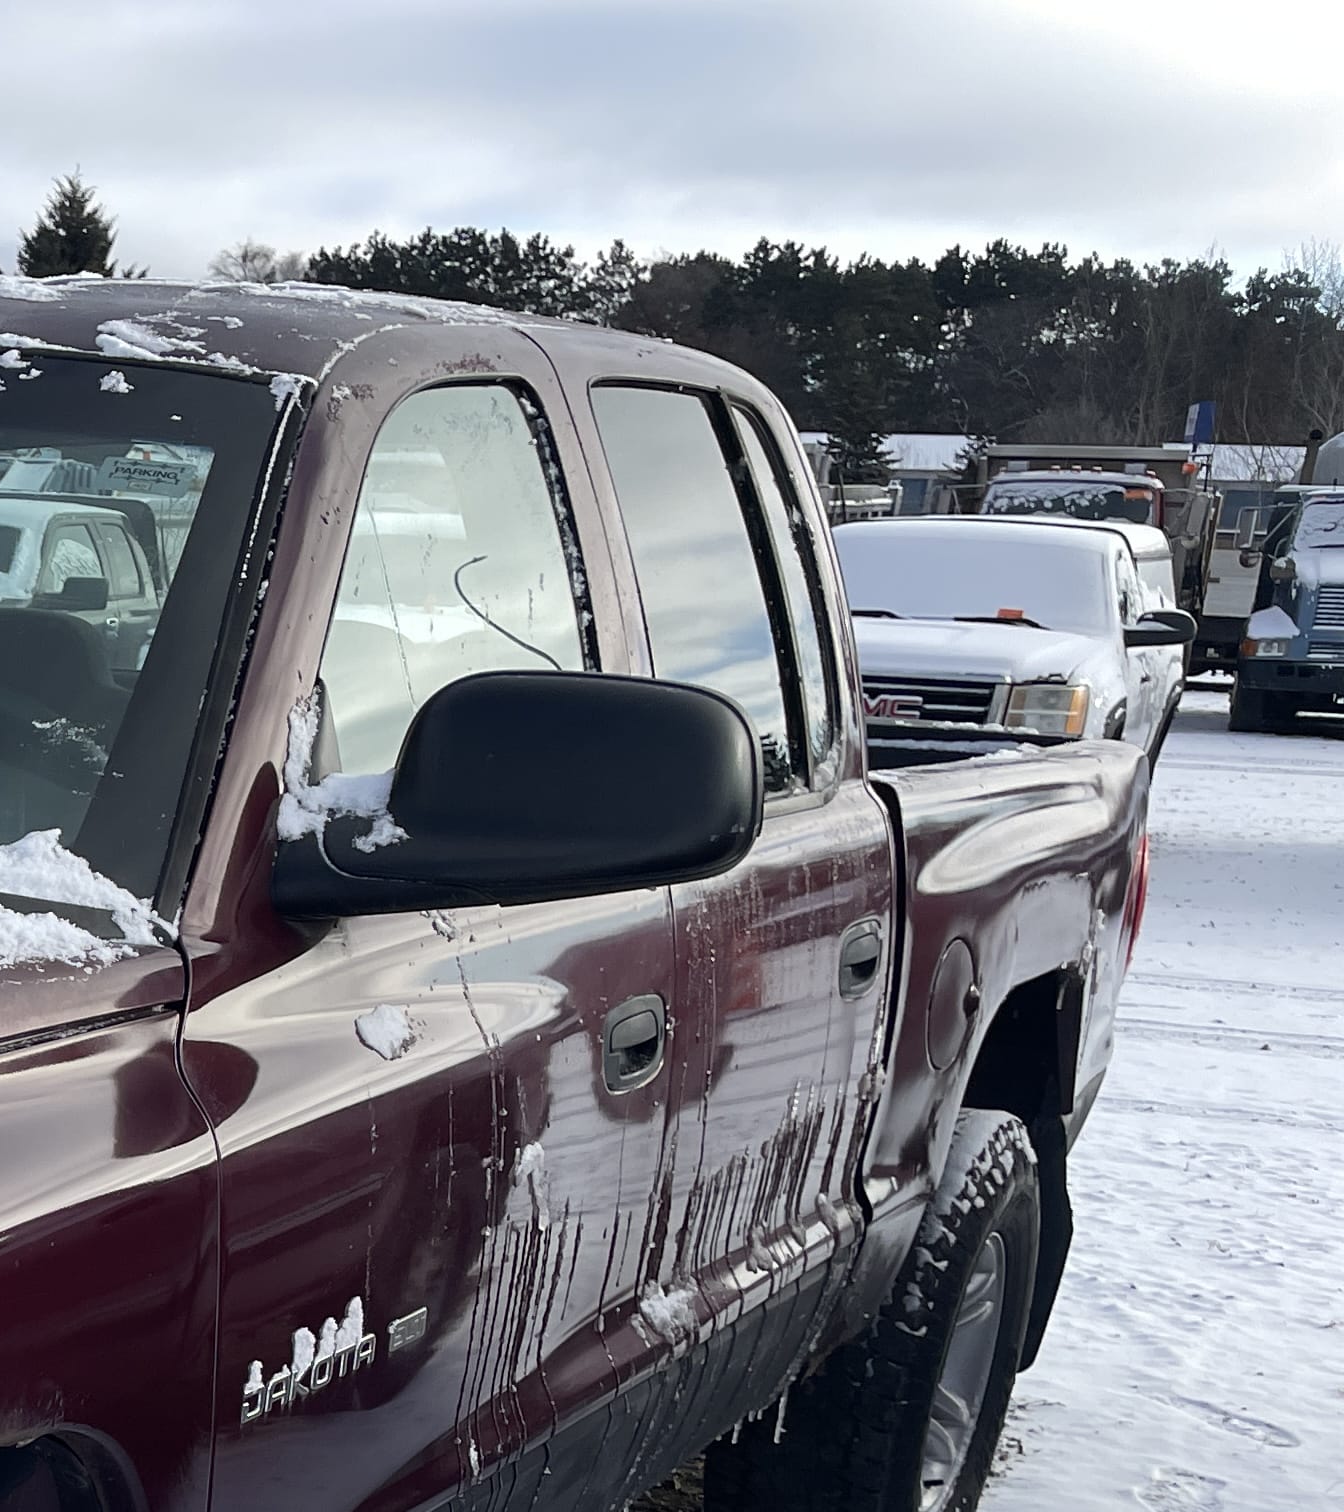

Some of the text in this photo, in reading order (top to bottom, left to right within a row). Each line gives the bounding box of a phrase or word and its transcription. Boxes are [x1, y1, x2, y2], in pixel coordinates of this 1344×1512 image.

[113, 465, 179, 481] PARKING
[863, 693, 923, 720] MC
[241, 1332, 376, 1423] DAKOTA
